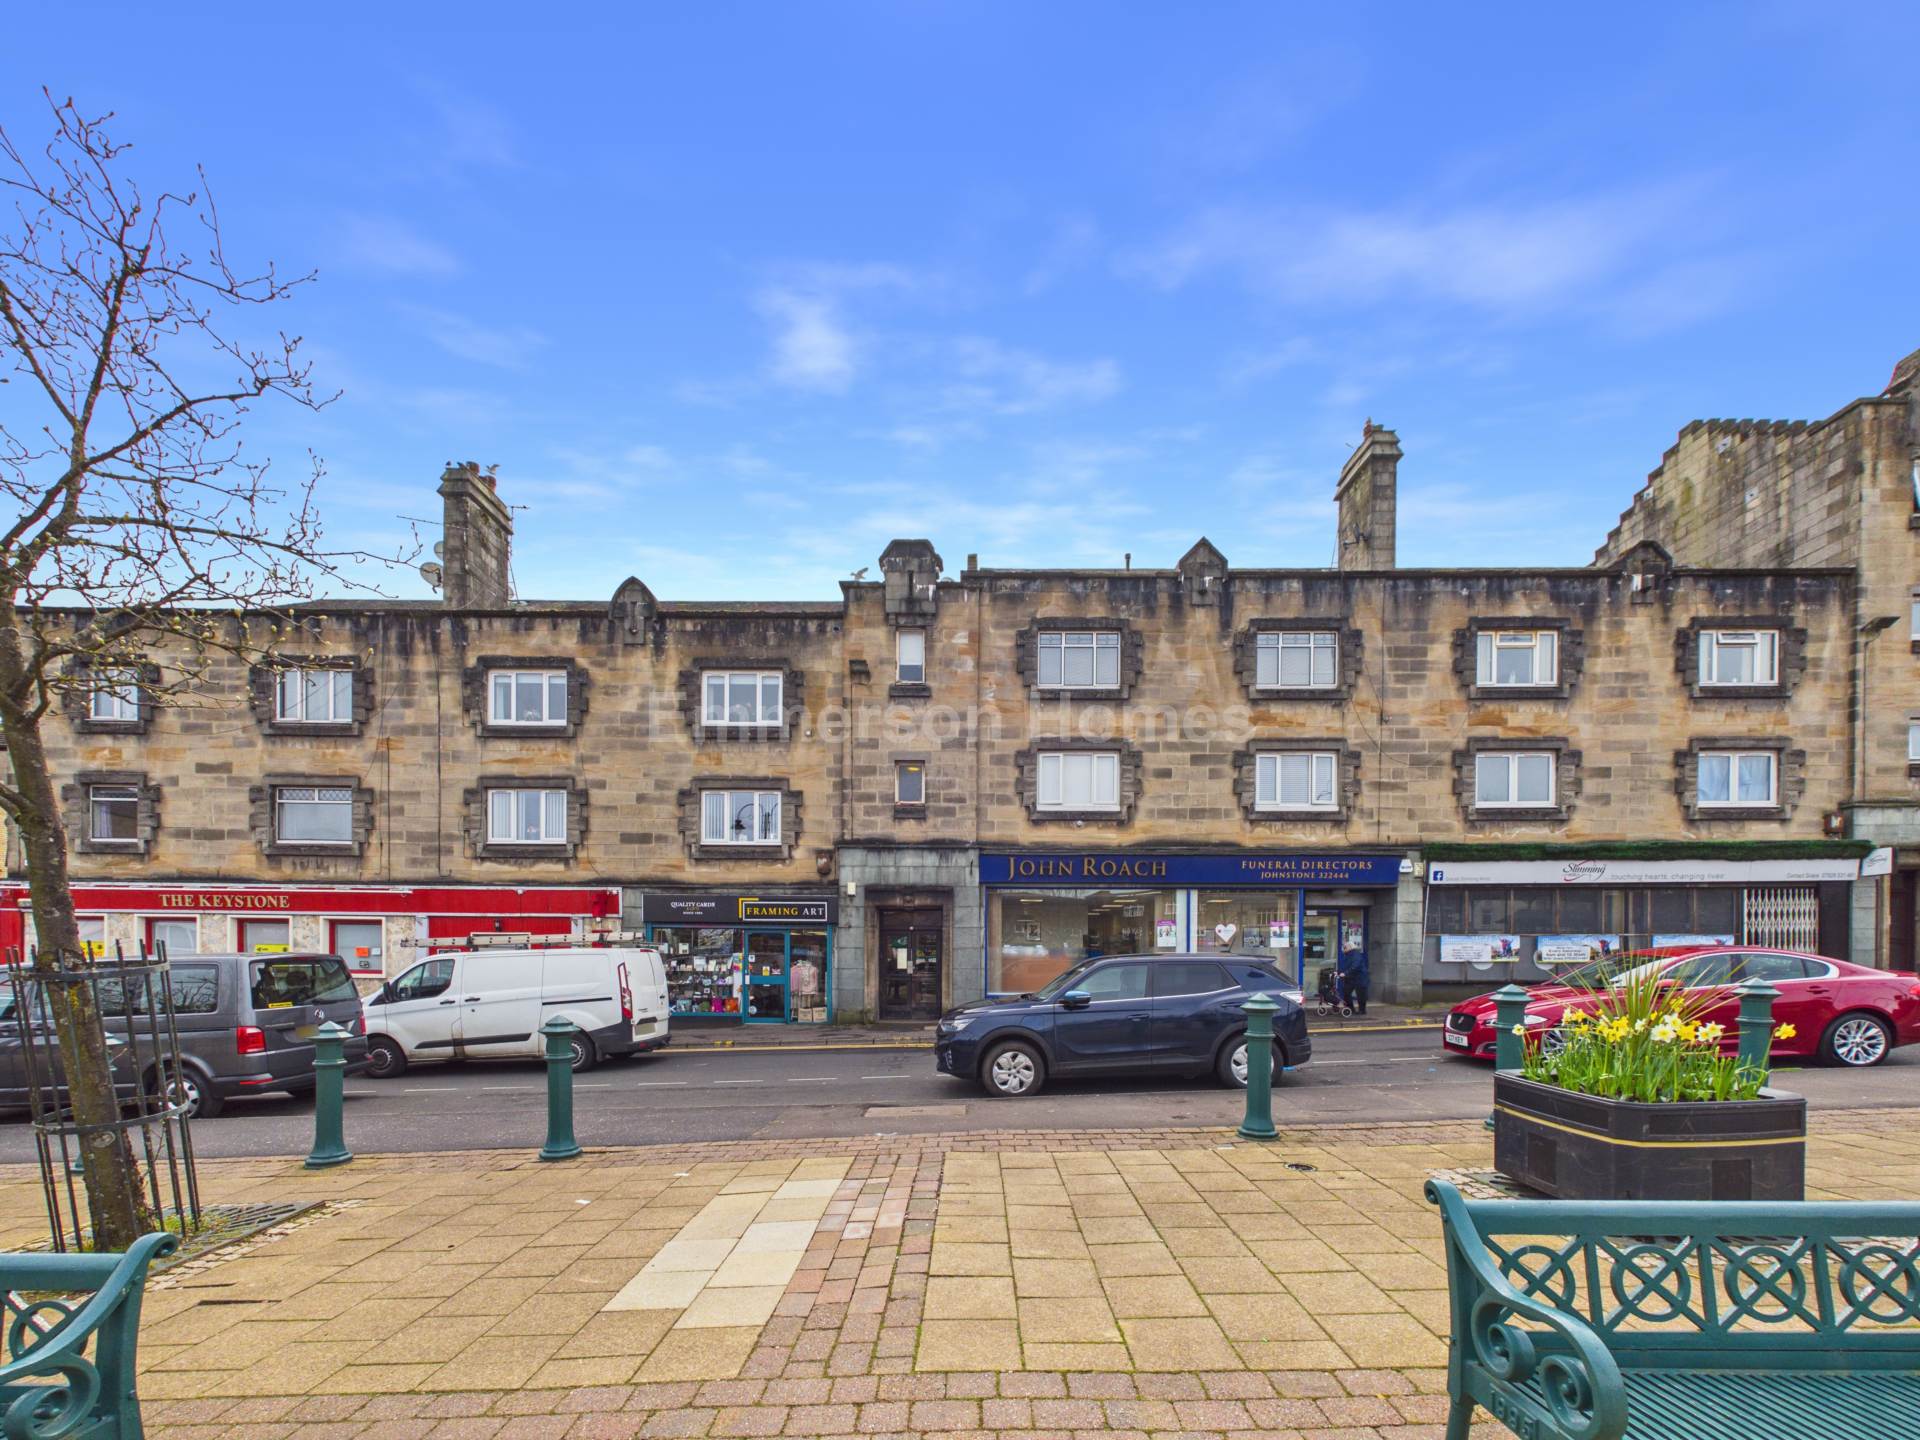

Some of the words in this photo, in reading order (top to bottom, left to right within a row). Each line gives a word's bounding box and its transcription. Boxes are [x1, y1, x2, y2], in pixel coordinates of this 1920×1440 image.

[1008, 856, 1073, 880] JOHN
[1082, 856, 1167, 876] ROACH
[1241, 860, 1297, 870] FUNERAL
[1301, 860, 1373, 870] DIRECTORS
[1562, 862, 1607, 879] Slimming
[1261, 871, 1315, 880] JOHNSTONE
[159, 894, 195, 907] THE
[198, 894, 290, 908] KEYSTONE
[746, 907, 799, 916] FRAMING
[802, 907, 825, 916] ART
